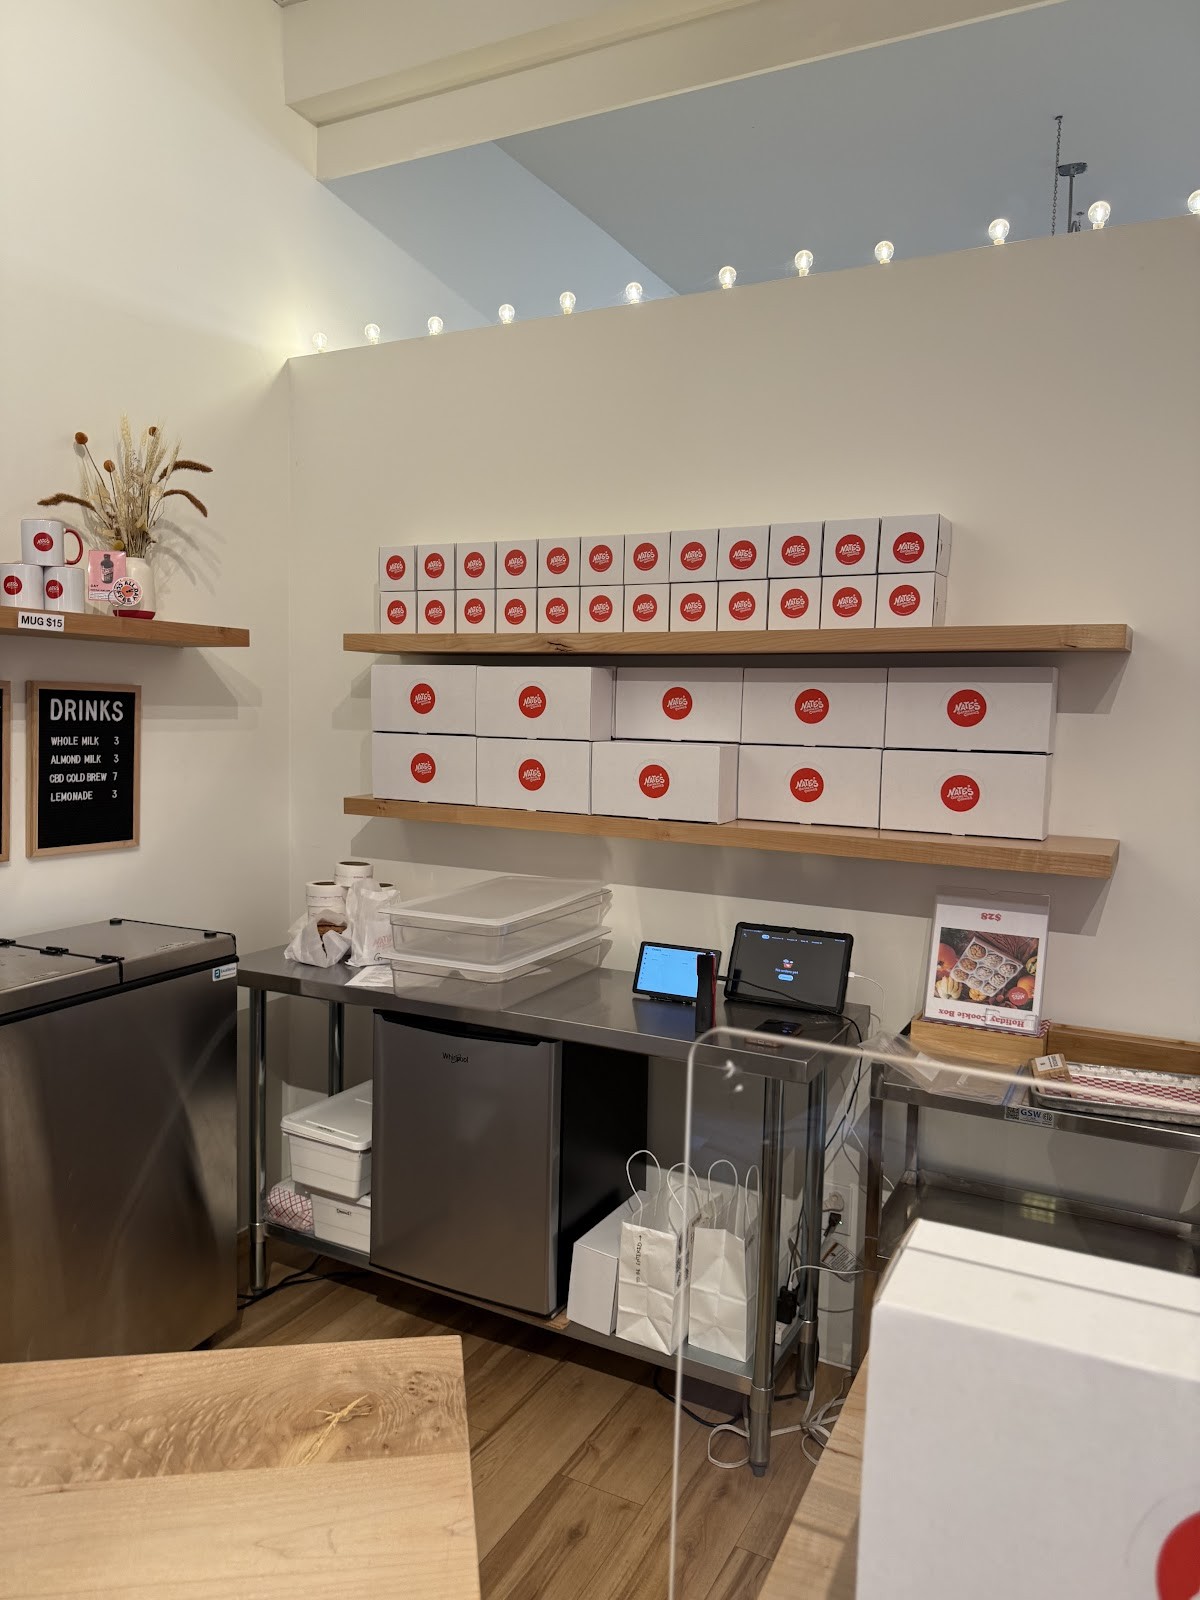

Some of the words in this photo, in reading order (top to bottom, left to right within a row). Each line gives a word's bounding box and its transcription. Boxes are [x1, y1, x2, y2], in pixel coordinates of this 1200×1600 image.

[785, 543, 806, 556] NATE'S
[839, 542, 861, 555] NATE'S
[897, 541, 920, 554] NATE'S
[785, 596, 805, 609] NATE'S
[837, 594, 858, 608] NATE'S
[894, 592, 916, 606] NATE'S
[21, 615, 44, 626] MUG
[46, 617, 62, 628] $15
[667, 696, 687, 709] NATE'S
[800, 698, 823, 712] NATE'S
[953, 699, 980, 714] NATE'S
[50, 698, 123, 722] DRINKS
[50, 736, 78, 746] WHOLE
[81, 736, 99, 746] MILK
[114, 736, 119, 745] 3
[50, 755, 81, 764] ALMOND
[84, 755, 101, 763] MILK
[114, 754, 119, 763] 3
[49, 774, 64, 783] CBD
[66, 773, 85, 783] COLD
[86, 773, 107, 782] BREW
[112, 772, 118, 780] 7
[644, 774, 665, 787] NATE'S
[795, 777, 818, 791] NATE'S
[50, 791, 93, 802] LEMONADE
[112, 790, 117, 798] 3
[947, 785, 973, 799] NATE'S
[980, 912, 1002, 921] $28
[938, 1008, 955, 1017] Box
[957, 1010, 986, 1021] Cookie
[990, 1015, 1024, 1027] Holiday
[1020, 1109, 1041, 1118] GSW
